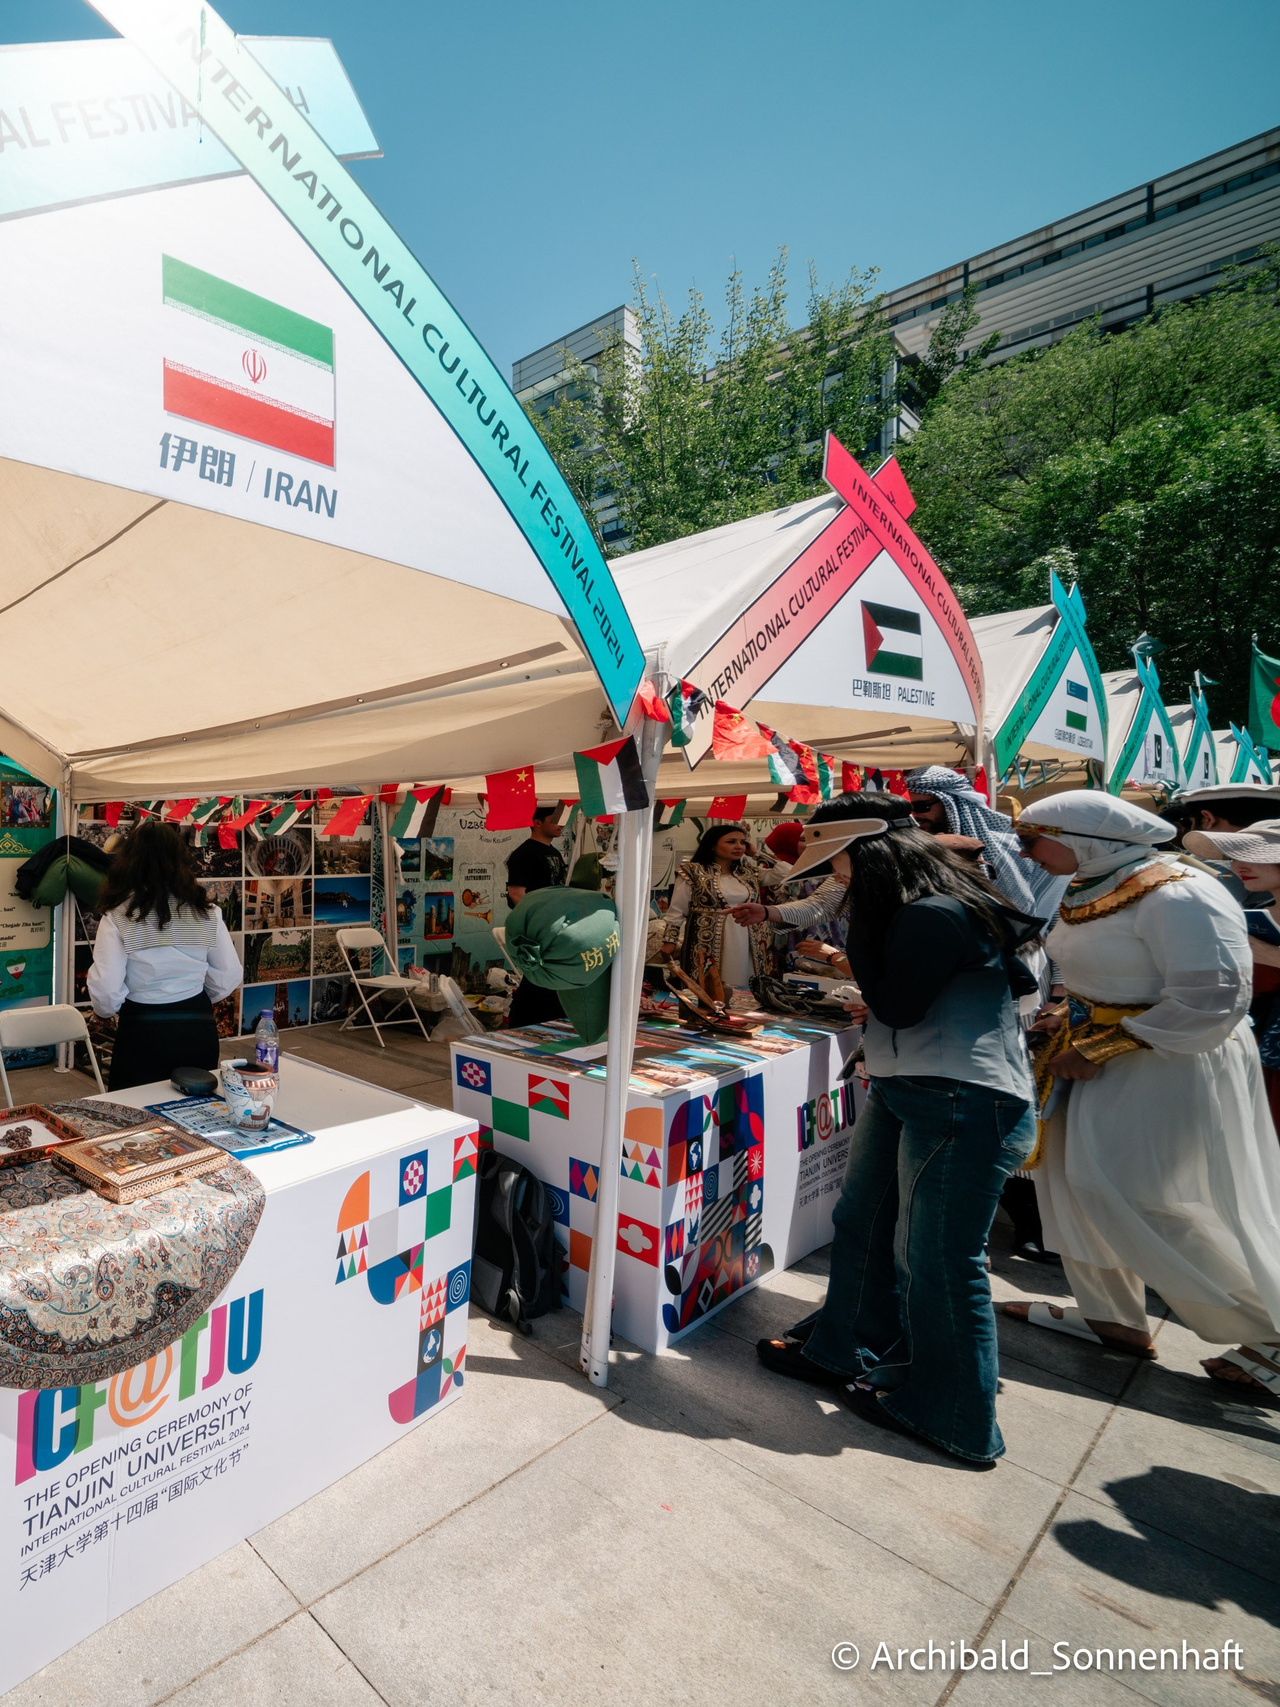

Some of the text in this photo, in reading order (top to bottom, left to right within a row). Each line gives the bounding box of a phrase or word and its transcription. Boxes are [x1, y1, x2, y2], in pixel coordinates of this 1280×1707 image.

[52, 91, 206, 144] FESTIVA
[160, 11, 626, 671] INTERNATIONAL CULTURAL FESTIVAL 2024
[159, 432, 236, 487] 伊朗
[263, 467, 338, 519] IRAN
[852, 478, 937, 597] INTERNATIONAL
[937, 592, 969, 662] CULTURAL
[698, 521, 871, 720] INTERNATIONAL CULTURAL FESTIVA
[852, 679, 891, 700] 巴勒斯坦
[897, 687, 936, 707] PALESTINE
[797, 1081, 856, 1153] ICF@TJU
[823, 1147, 849, 1168] UNIVERS
[20, 1424, 251, 1557] INTERNATIONAL CULTURAL FESTIVAL 2024
[23, 1401, 252, 1537] TIANJIN UNIVERSITY
[24, 1383, 253, 1511] THE OPENING CEREMONY OF
[19, 1444, 250, 1591] 天津大学第十四届“国际文化节”
